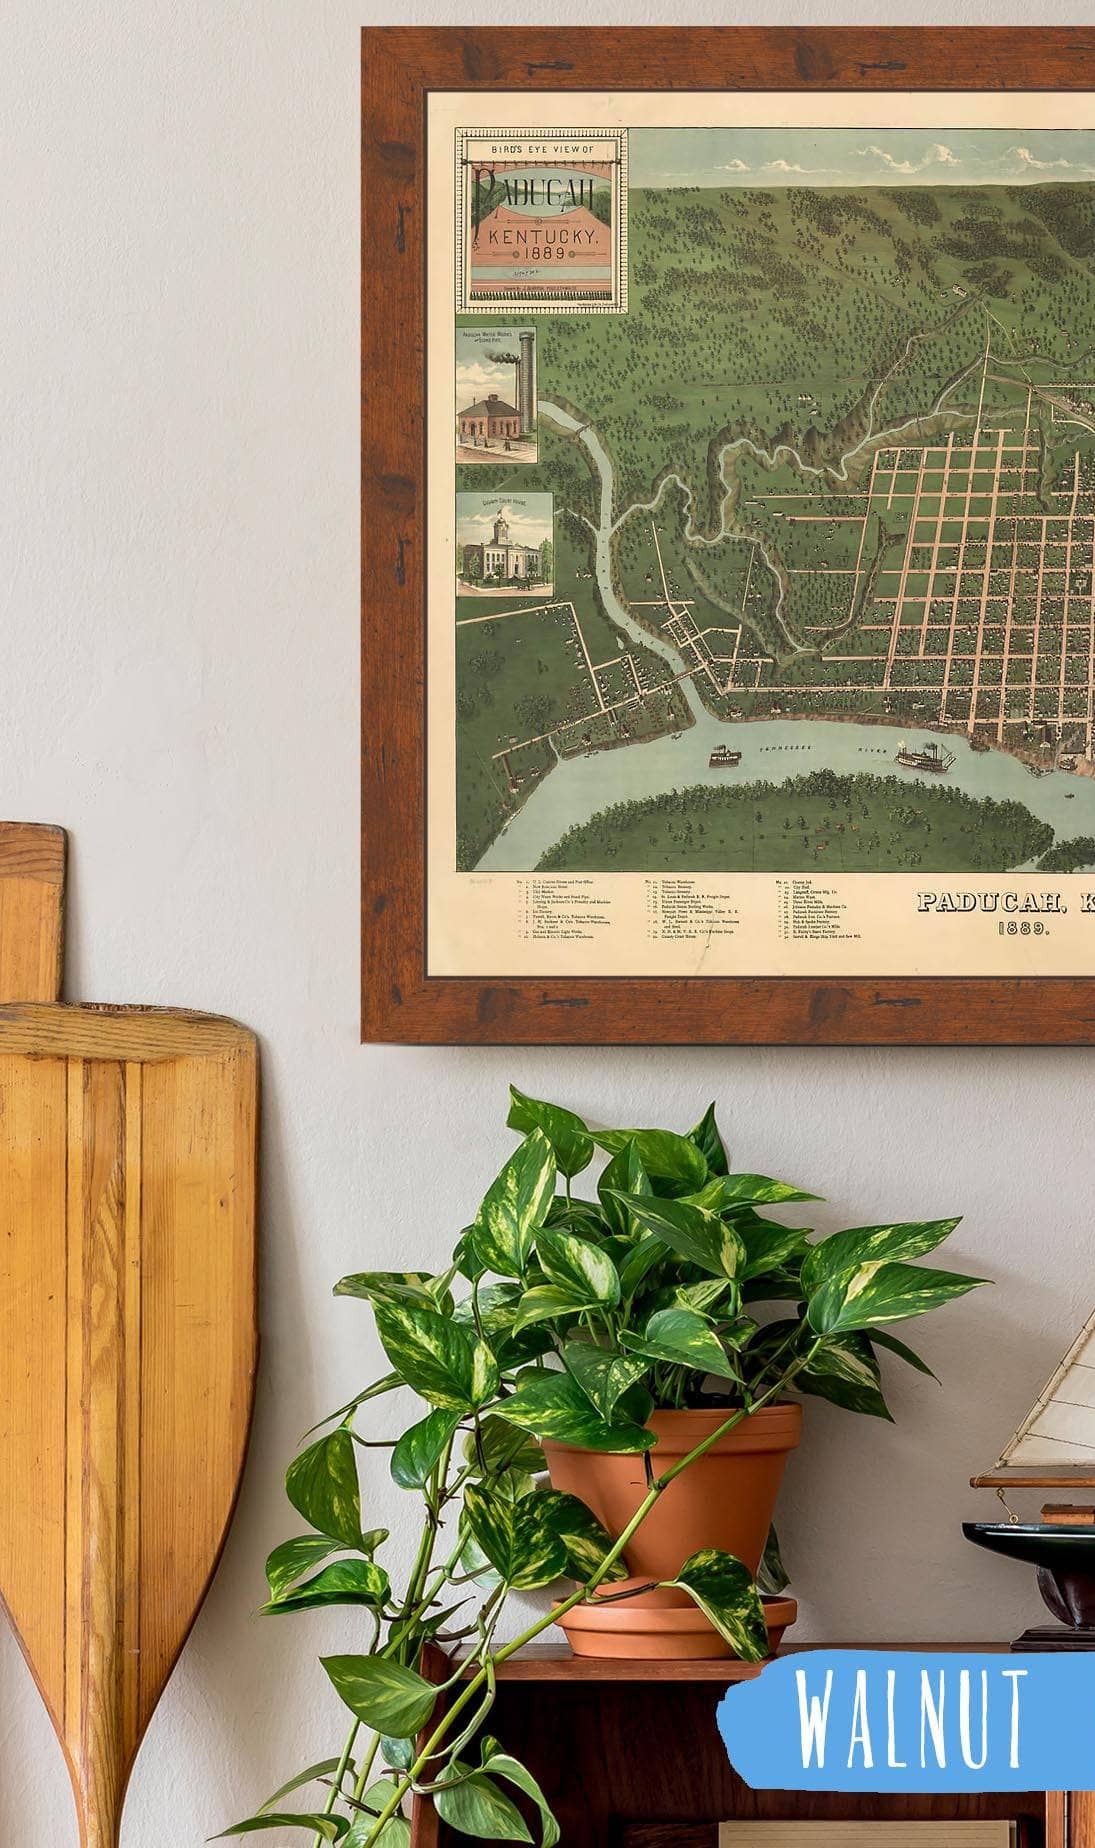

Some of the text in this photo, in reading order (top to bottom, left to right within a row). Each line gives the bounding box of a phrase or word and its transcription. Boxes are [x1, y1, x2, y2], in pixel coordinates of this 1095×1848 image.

[528, 145, 547, 154] EYE
[553, 145, 580, 154] VIEW
[582, 145, 594, 154] OF
[471, 166, 595, 242] PADUCAH
[489, 229, 599, 245] KENTUCKY.
[525, 247, 565, 260] 1889
[917, 892, 1067, 914] PADUCAH,
[998, 921, 1050, 935] 1889.
